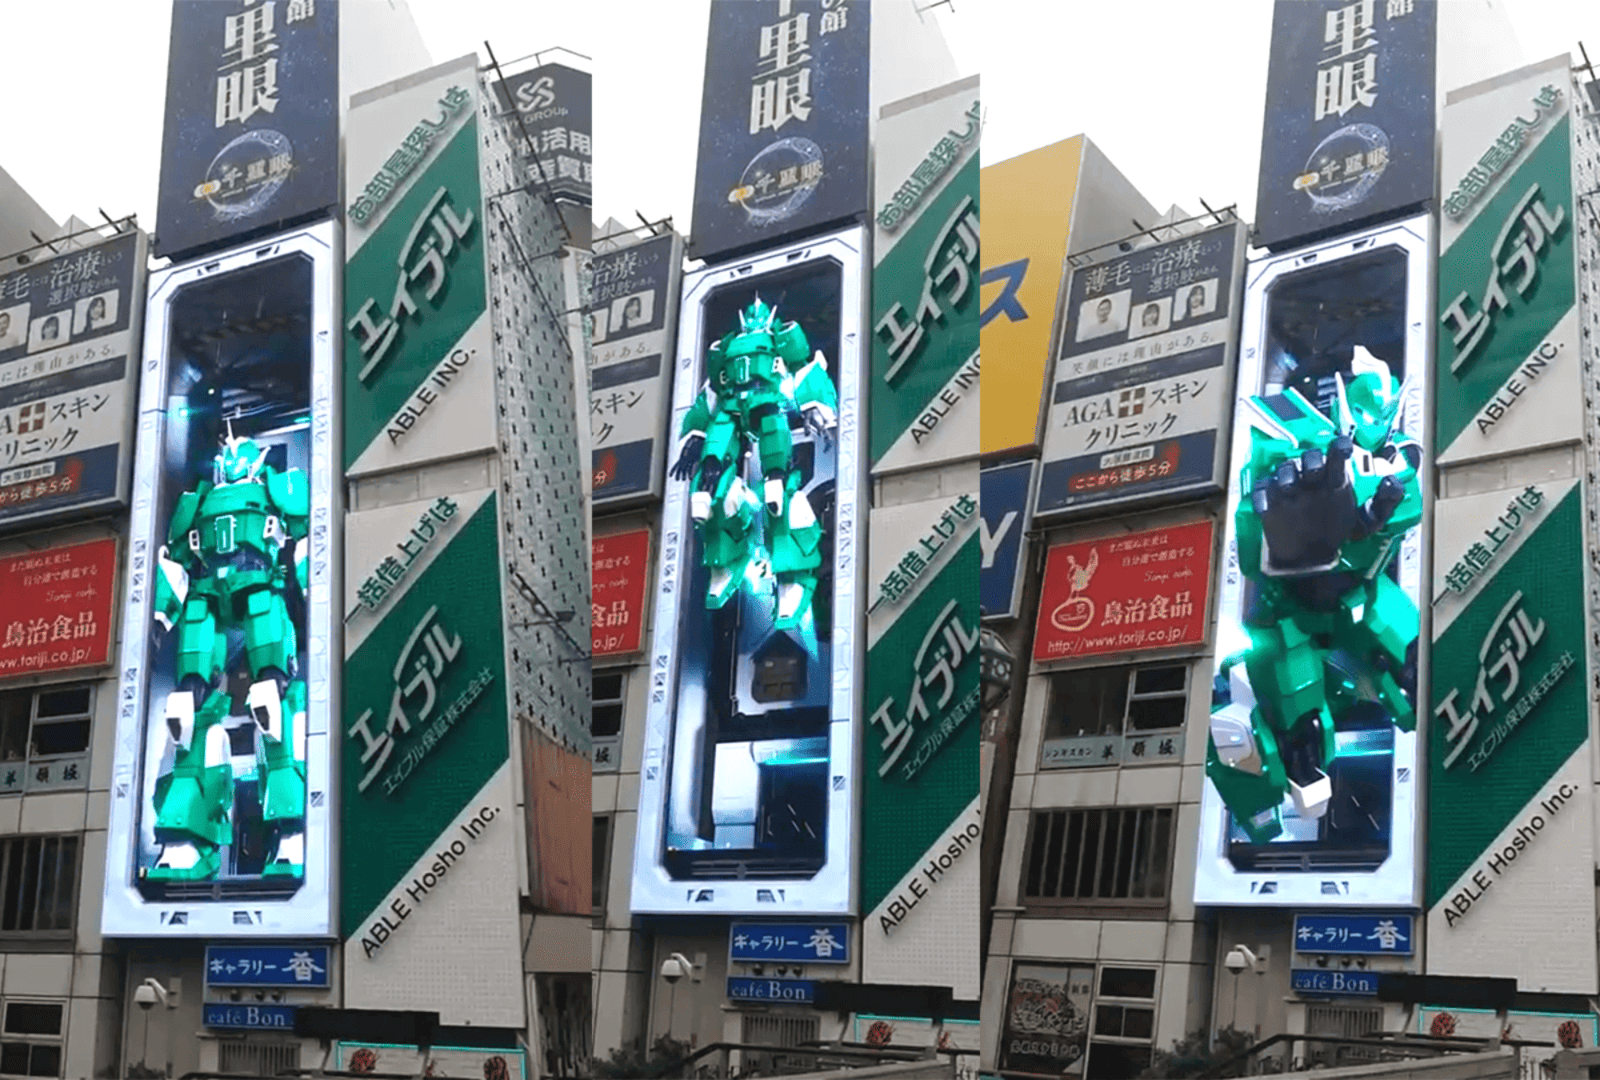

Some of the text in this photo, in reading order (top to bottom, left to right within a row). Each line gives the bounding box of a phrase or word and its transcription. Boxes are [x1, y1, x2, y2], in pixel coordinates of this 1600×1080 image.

[215, 0, 280, 129] 里眼
[750, 0, 813, 135] 里眼
[348, 85, 470, 222] お部屋探しは
[1442, 84, 1563, 215] お部屋探しは
[348, 185, 475, 382] エイブル
[1440, 182, 1565, 374] エイブル
[50, 394, 110, 423] スキン
[386, 347, 477, 445] ABLE INC.
[910, 388, 960, 444] ABLE
[1063, 397, 1115, 428] AGA
[1084, 412, 1178, 451] クリニック
[1149, 380, 1208, 409] スキン
[1476, 341, 1565, 435] ABLE INC.
[342, 495, 459, 624] 一括借上げは
[865, 493, 978, 616] 一括借上げは
[1430, 484, 1544, 607] 一括借上げは
[348, 603, 463, 793] エイブル
[869, 597, 980, 779] エイブル
[1048, 624, 1189, 654] http://www.toriji.co.jp/
[1434, 588, 1546, 770] エイブル
[382, 665, 495, 796] エイブル保証株式会社
[1467, 649, 1577, 773] エイブル保証株式会社
[361, 806, 501, 959] ABLE Hosho Inc.
[879, 823, 980, 935] ABLE Hosho
[1443, 783, 1579, 928] ABLE Hosho Inc.
[209, 958, 277, 976] ギャラリー
[731, 981, 805, 1000] café Bon
[734, 933, 799, 951] ギャラリー
[1295, 973, 1369, 992] café Bon
[1298, 926, 1362, 943] ギャラリー
[208, 1006, 285, 1026] café Bon
